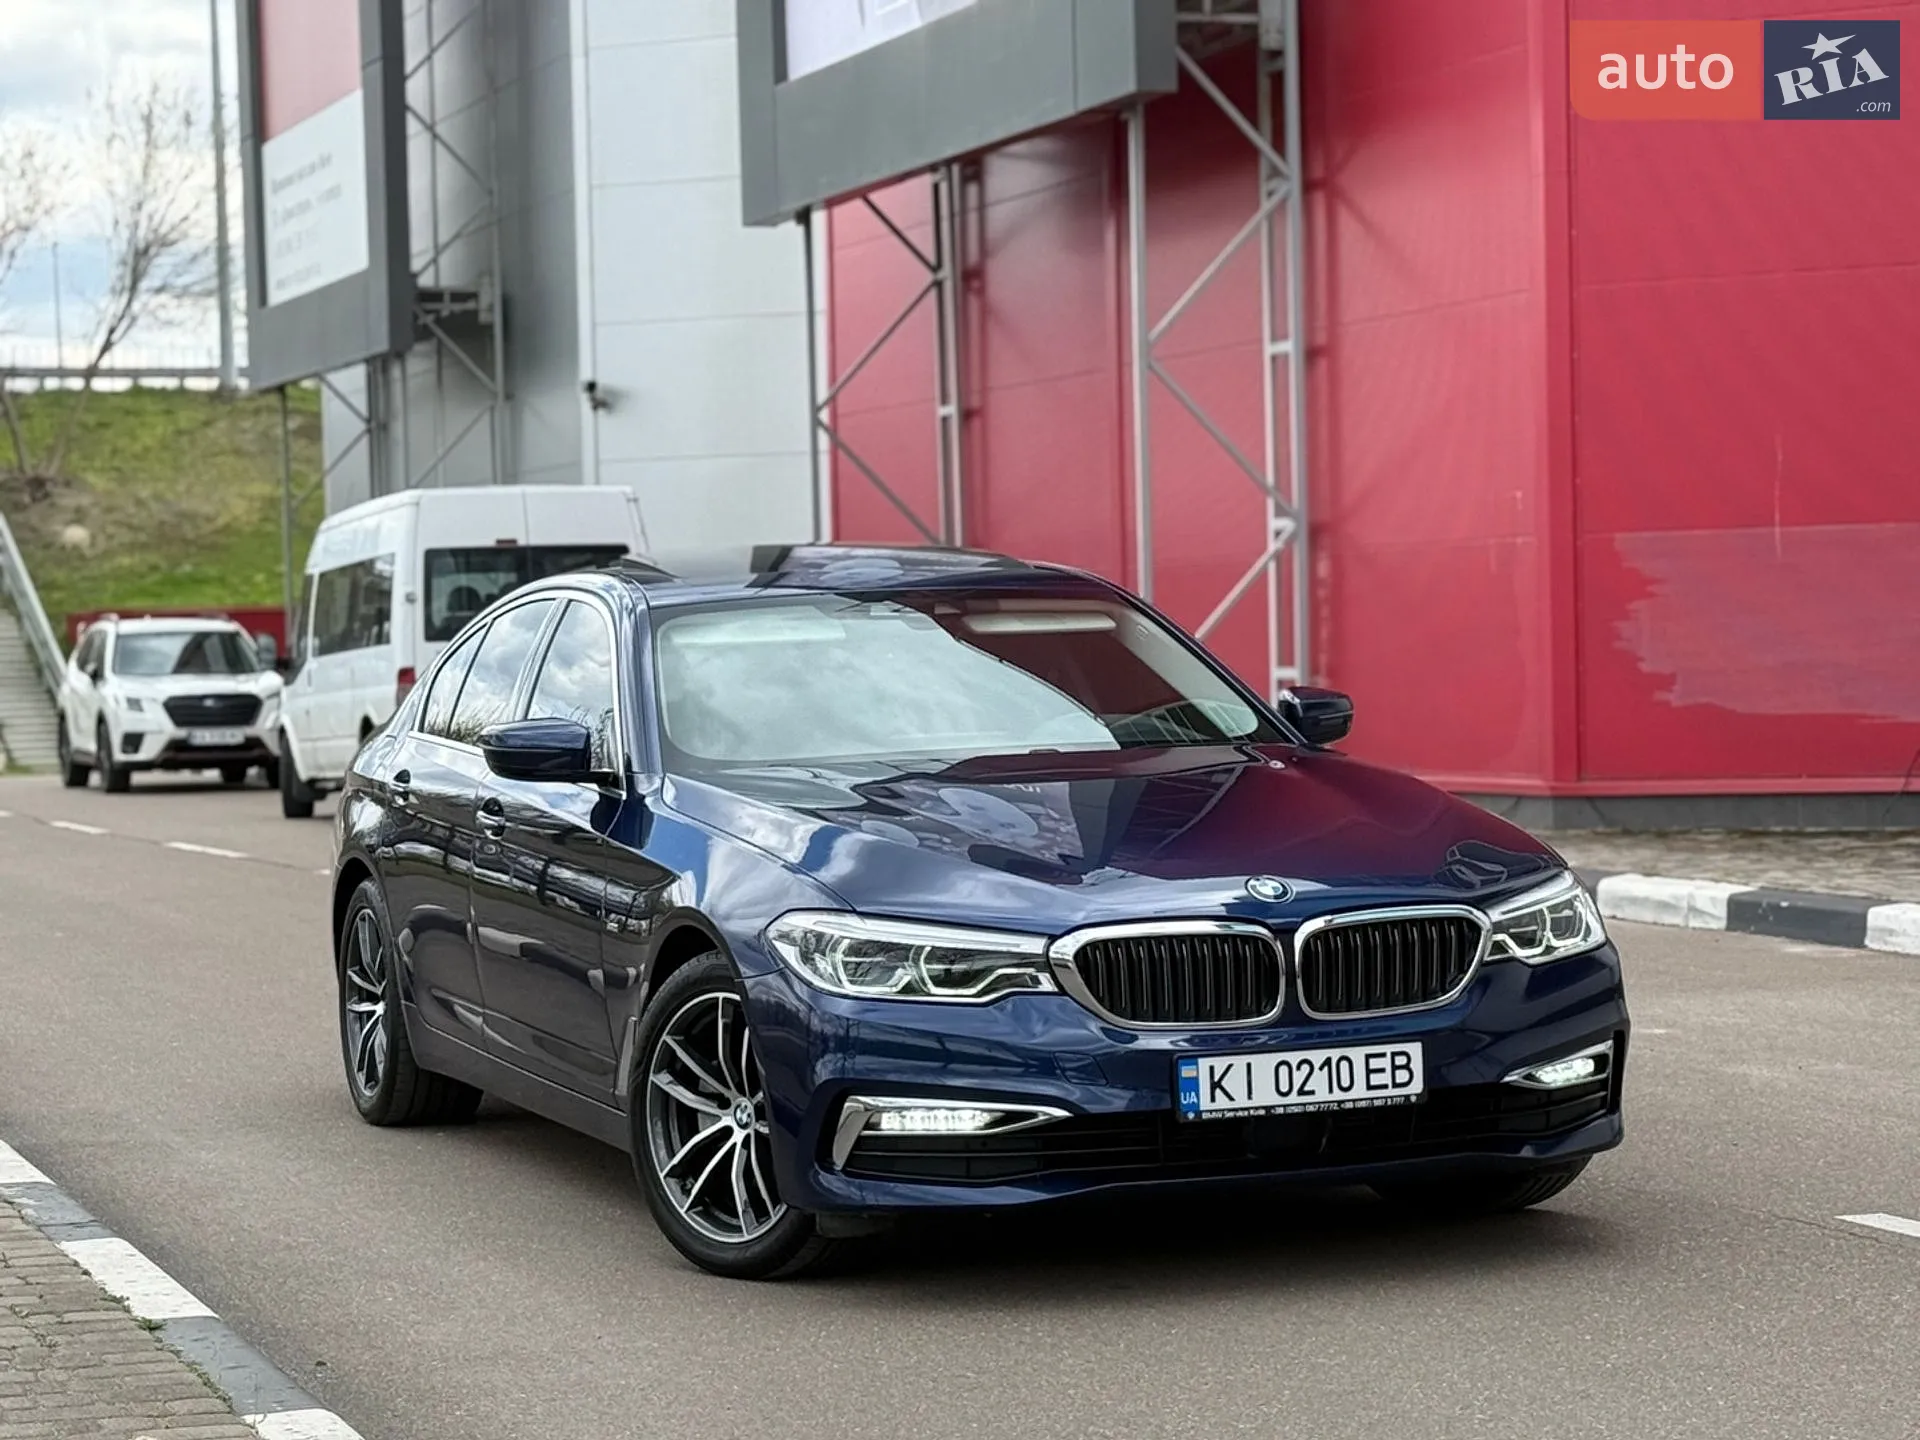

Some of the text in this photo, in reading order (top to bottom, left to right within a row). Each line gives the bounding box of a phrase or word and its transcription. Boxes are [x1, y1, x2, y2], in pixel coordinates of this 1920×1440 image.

[1209, 1050, 1414, 1103] KI 0210 EB
[1180, 1092, 1197, 1105] UA
[1223, 1109, 1248, 1118] Service
